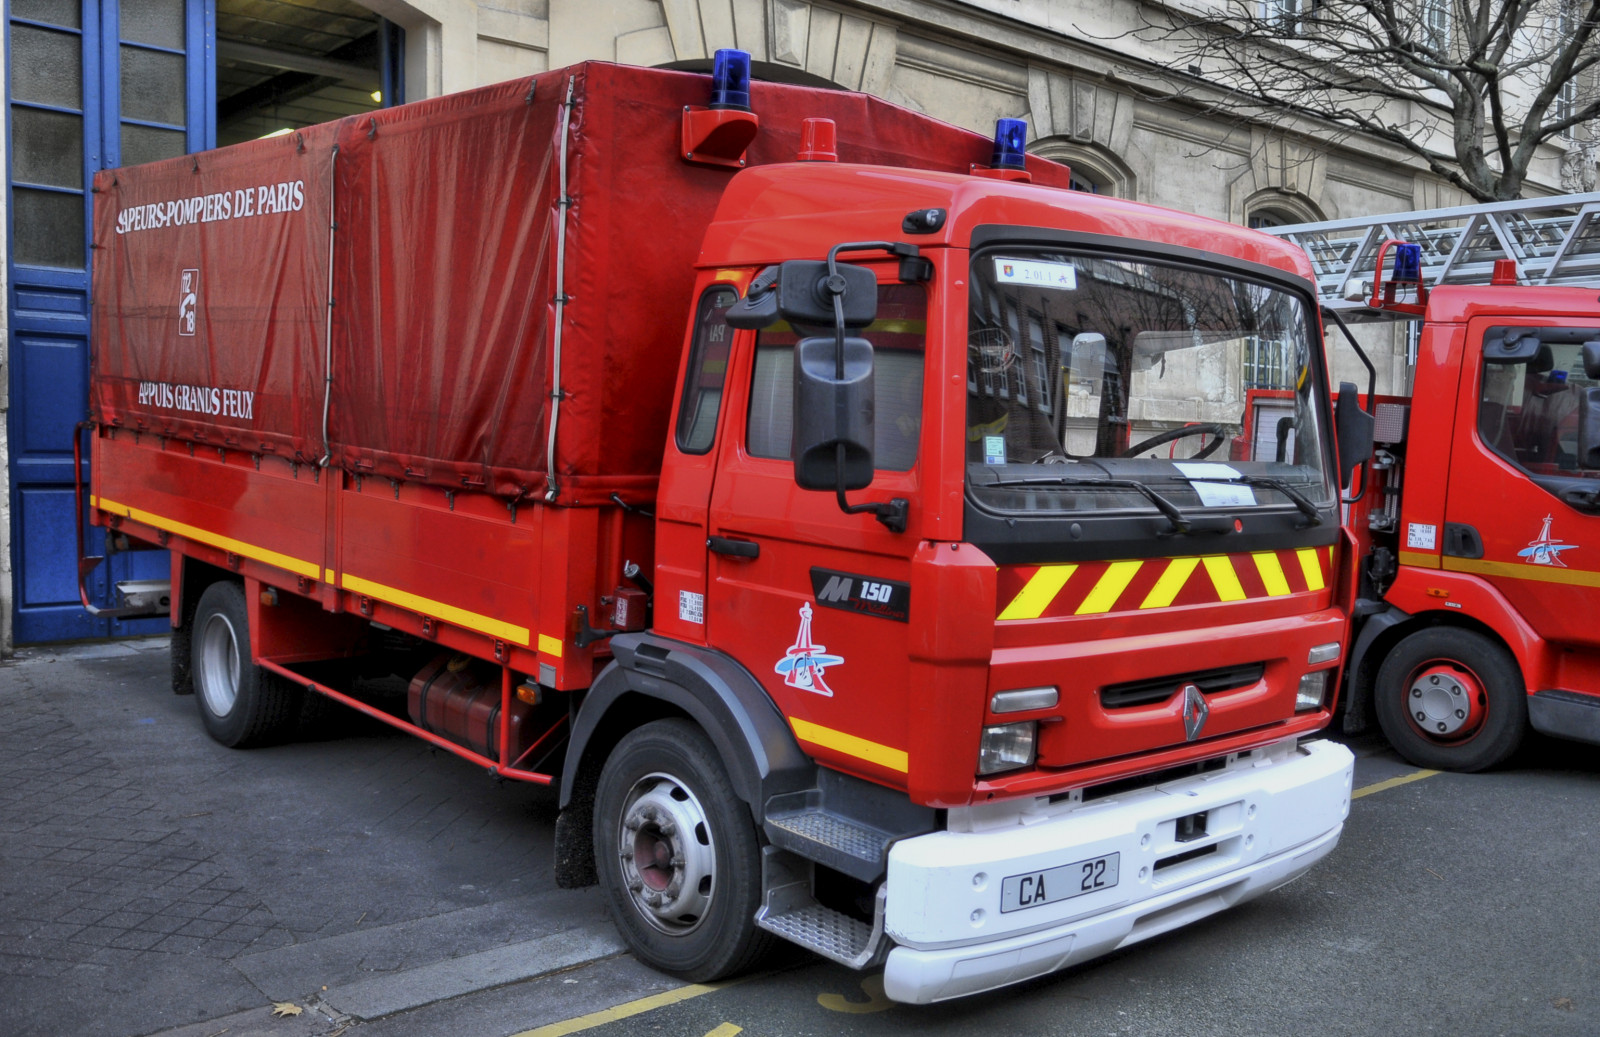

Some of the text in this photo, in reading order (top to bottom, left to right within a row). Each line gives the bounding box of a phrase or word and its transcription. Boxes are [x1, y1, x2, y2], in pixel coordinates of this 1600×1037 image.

[234, 188, 255, 219] DE
[257, 180, 304, 215] PARIS
[182, 272, 192, 294] 112
[186, 310, 194, 332] 18
[175, 384, 221, 415] GRANDS
[222, 388, 254, 419] FEUX
[817, 575, 893, 603] M 150
[1019, 859, 1106, 906] CA 22
